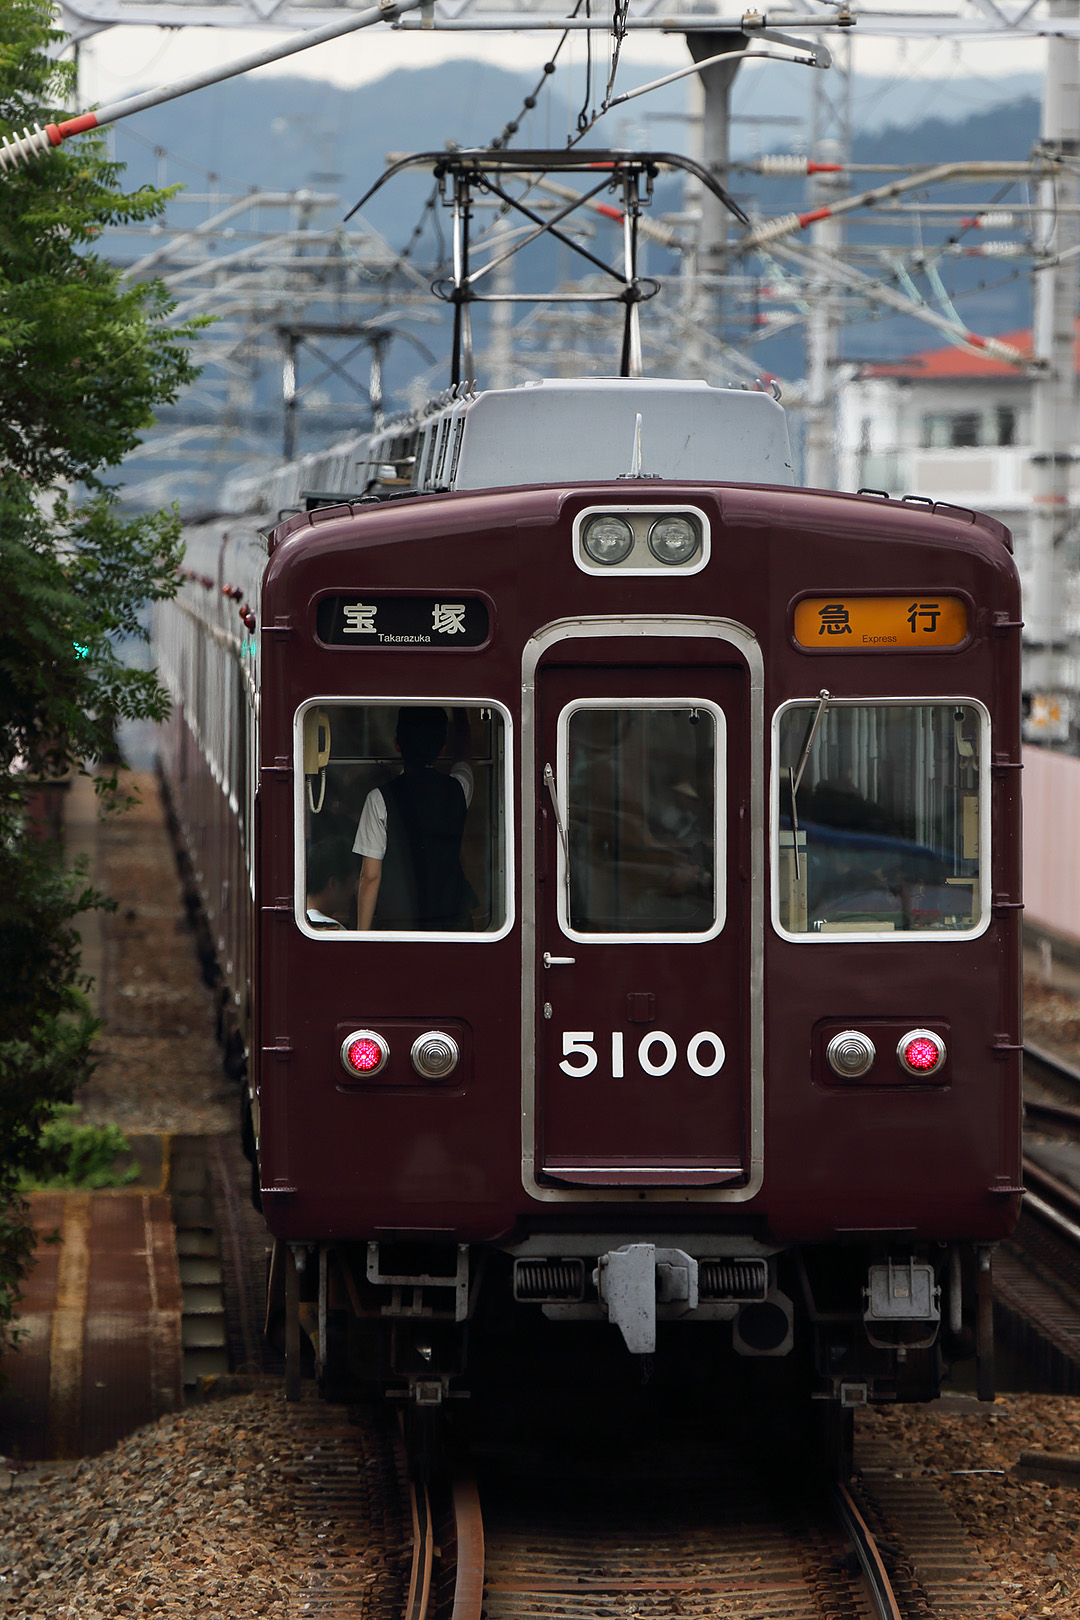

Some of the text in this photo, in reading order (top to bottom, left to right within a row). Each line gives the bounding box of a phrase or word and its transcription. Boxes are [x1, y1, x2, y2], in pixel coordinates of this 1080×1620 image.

[343, 603, 466, 634] 宝塚
[818, 603, 941, 635] 急行
[378, 633, 431, 643] Takarazuka
[862, 634, 897, 644] Express
[558, 1030, 726, 1079] 5100
